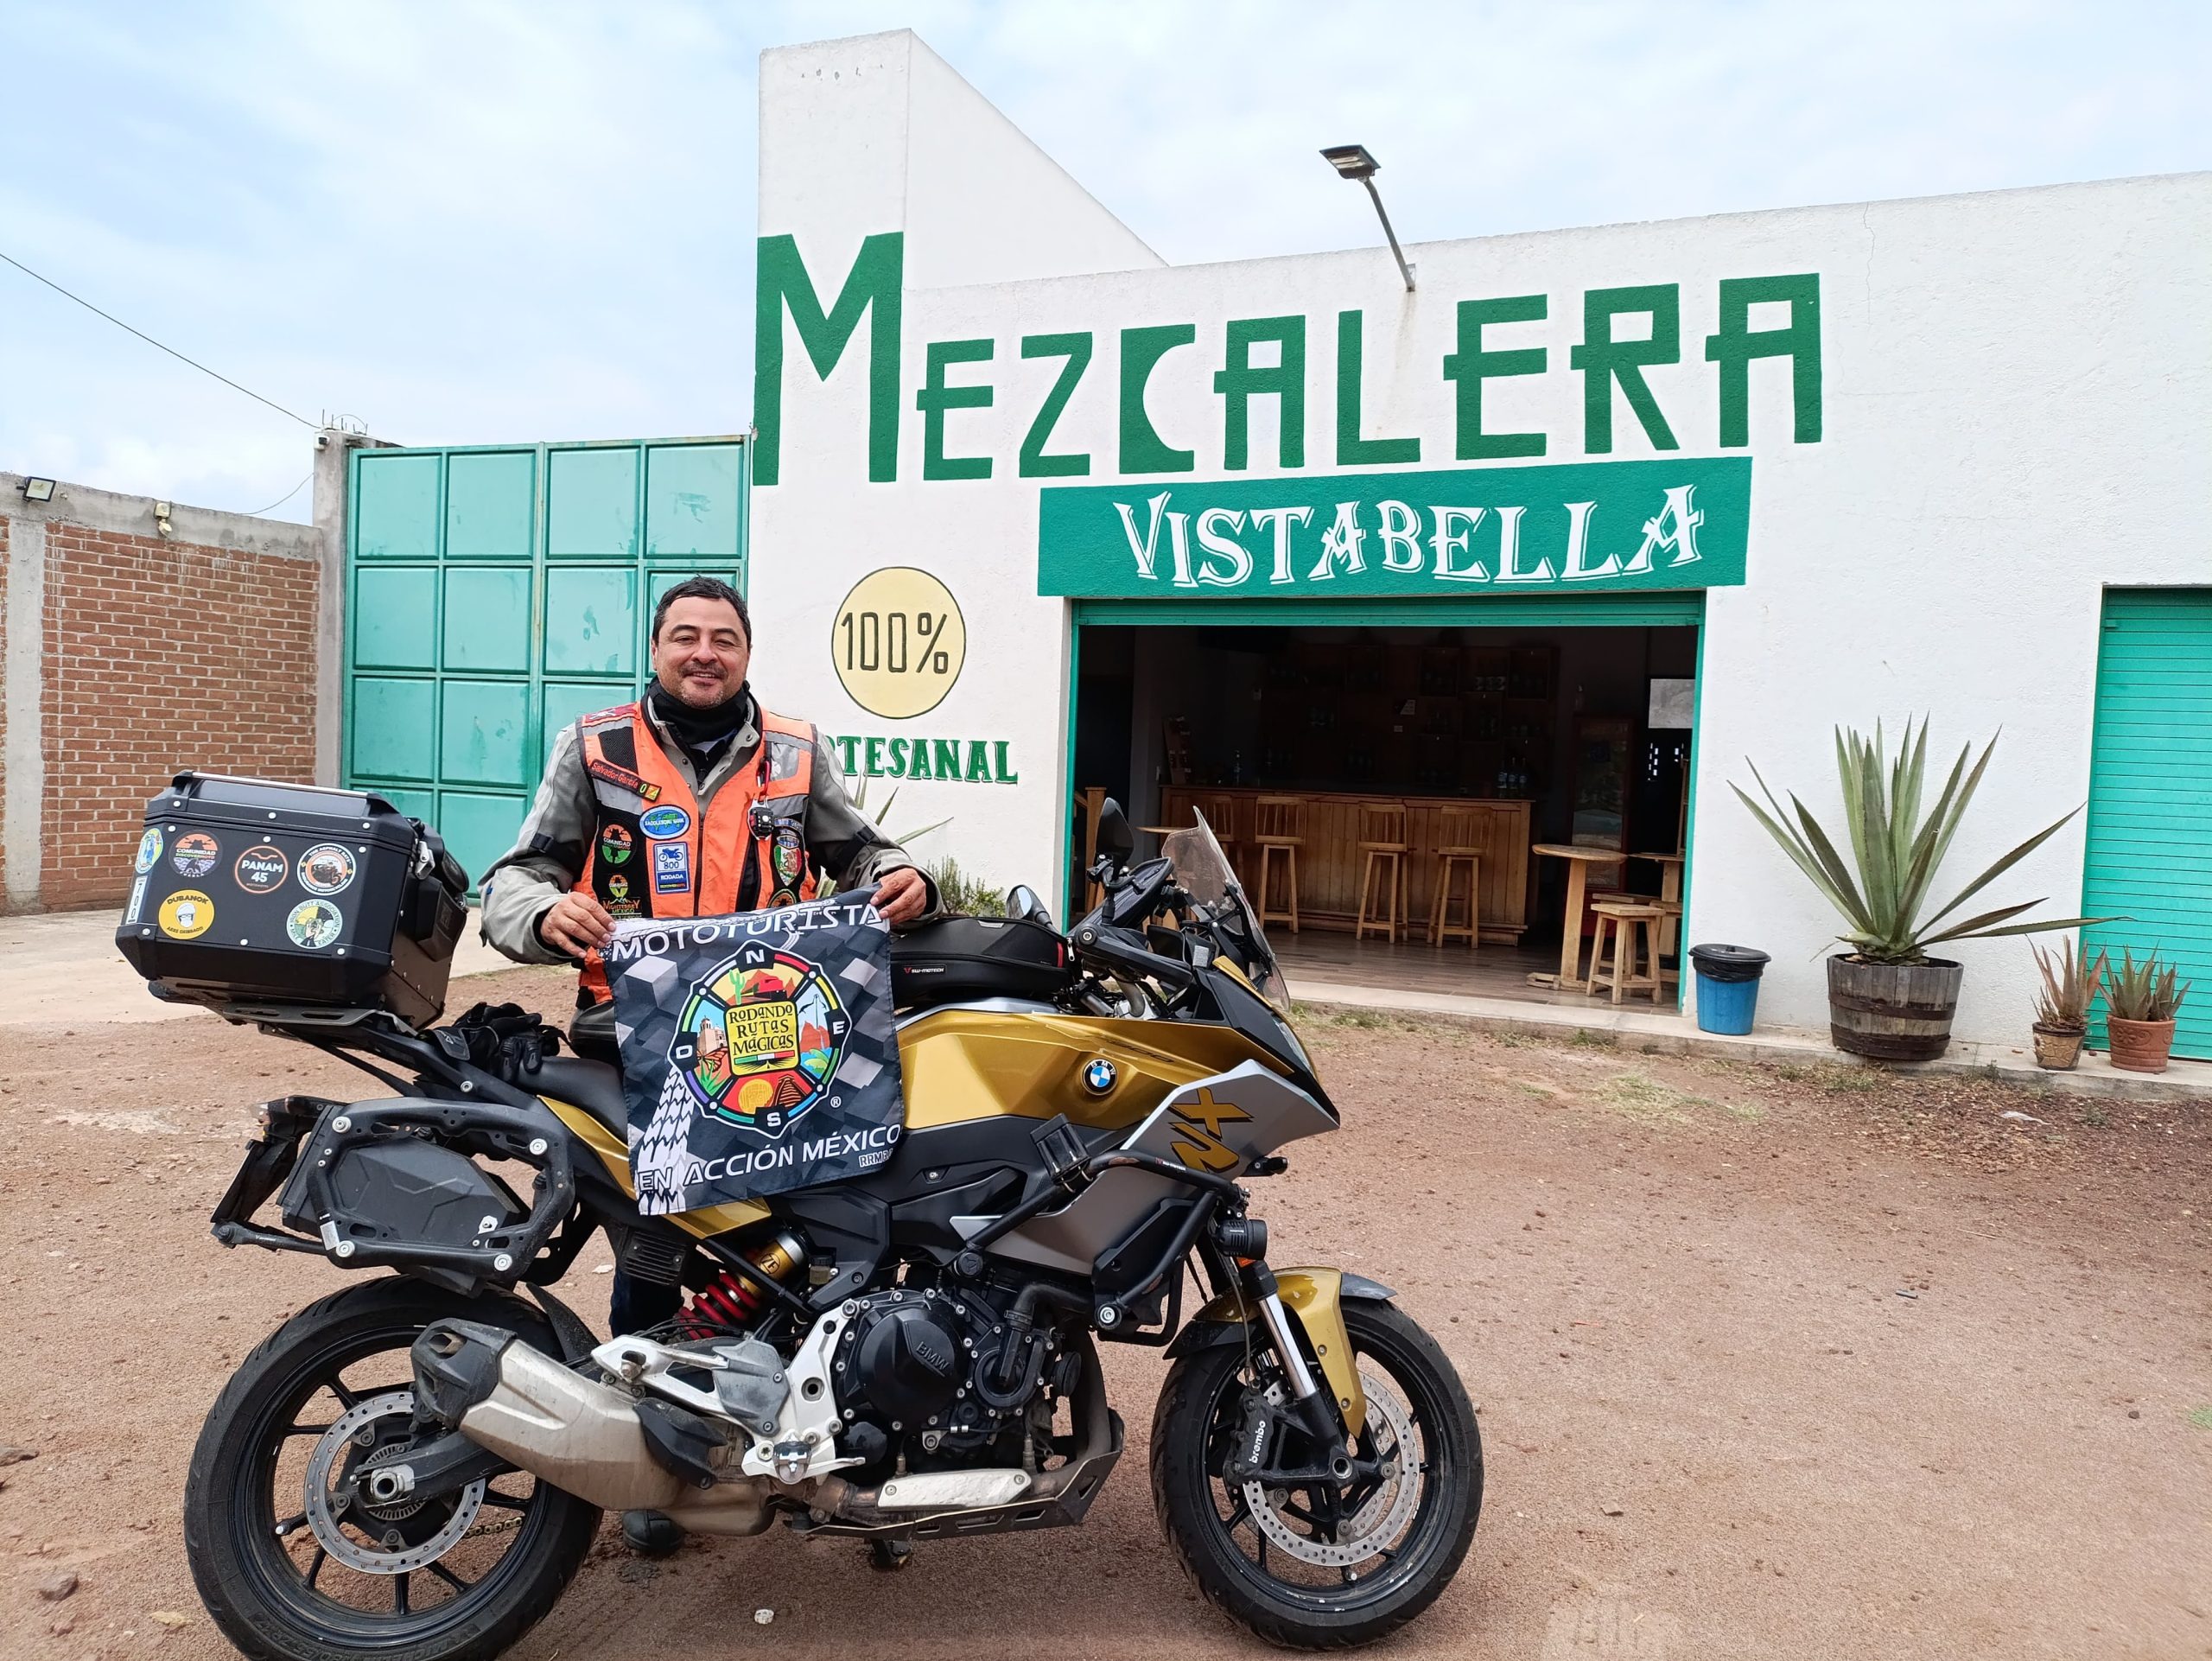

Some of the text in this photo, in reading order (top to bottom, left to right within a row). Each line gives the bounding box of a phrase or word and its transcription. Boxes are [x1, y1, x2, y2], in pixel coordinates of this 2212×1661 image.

[752, 232, 1823, 487] MEZCALERA
[1113, 483, 1706, 588] VISTABELLA
[841, 611, 949, 675] 100%
[592, 761, 618, 780] Salvador
[826, 735, 1019, 785] TESANAL
[603, 837, 631, 847] COMUNIDAD
[241, 859, 283, 873] PANAM
[251, 871, 269, 883] 45
[664, 861, 679, 869] 800
[612, 903, 882, 962] MOTOTURISTA
[746, 949, 765, 965] N
[833, 1020, 845, 1034] E
[767, 1111, 781, 1127] S
[639, 1125, 900, 1191] EN ACCIÓN MÉXICO
[916, 1340, 950, 1371] BMW
[1249, 1420, 1266, 1464] brembo
